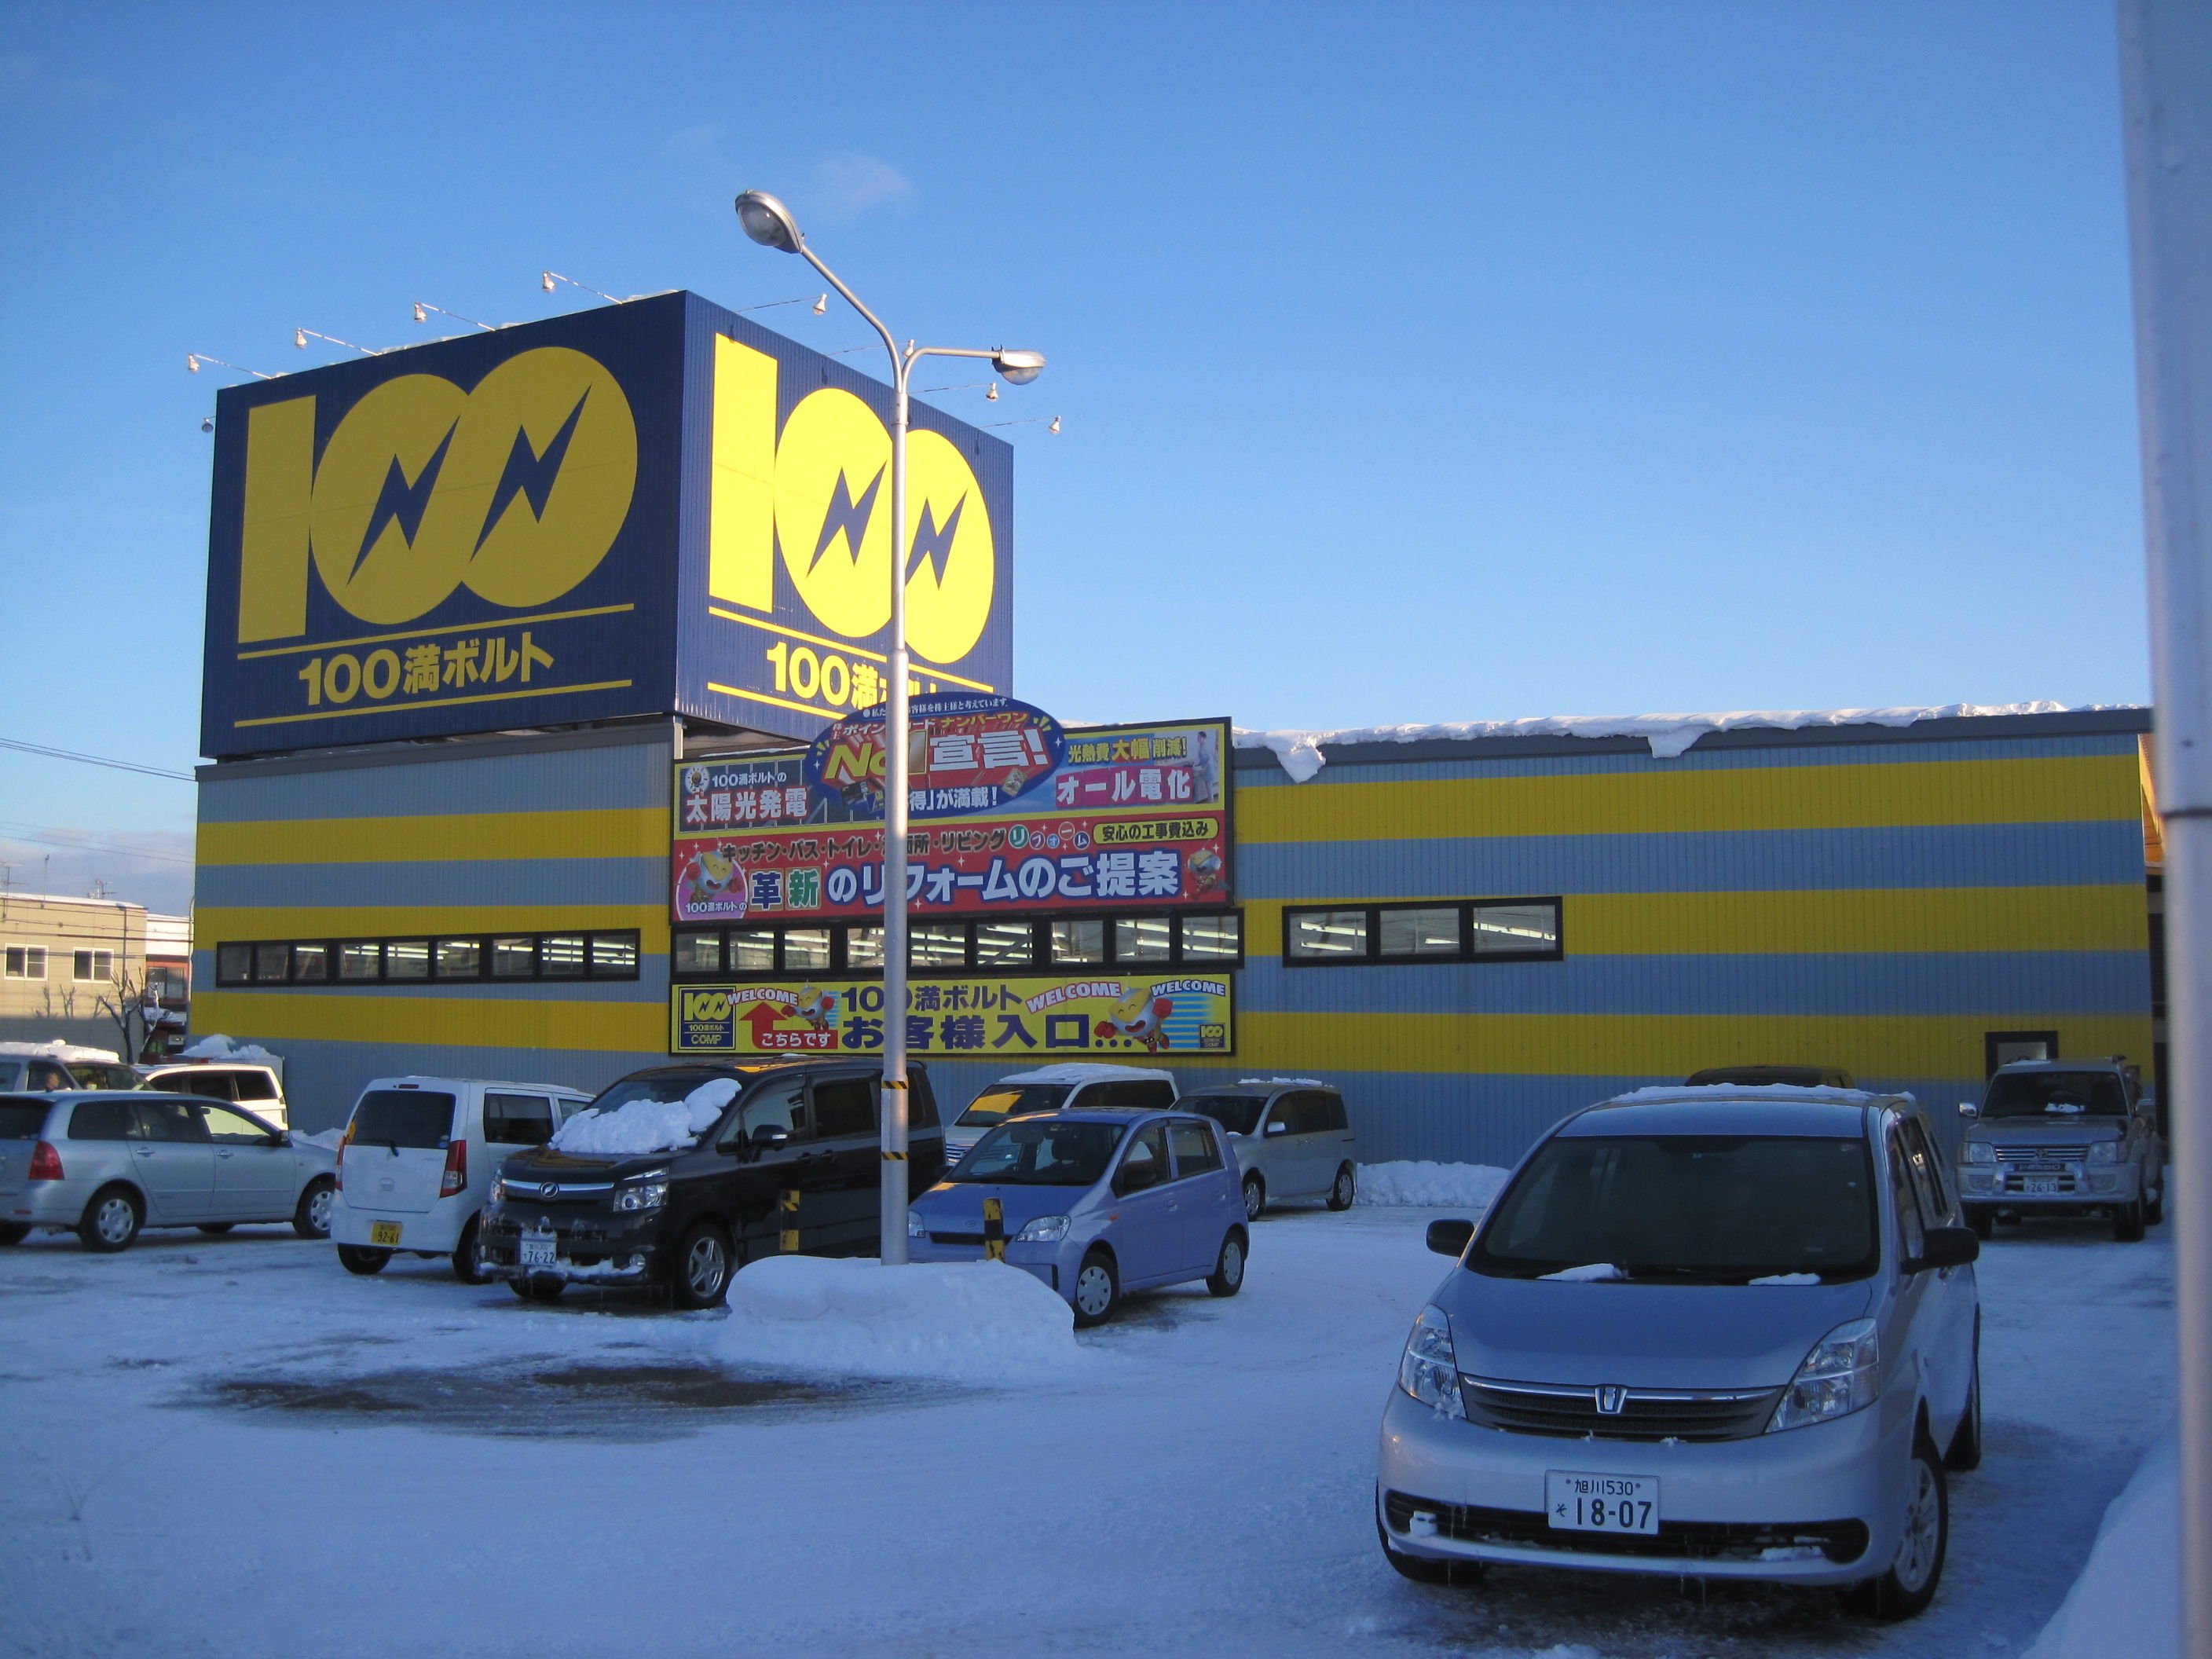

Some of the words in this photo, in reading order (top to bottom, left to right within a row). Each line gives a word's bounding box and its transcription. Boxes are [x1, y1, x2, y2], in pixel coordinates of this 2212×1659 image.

[238, 346, 638, 643] 100
[709, 332, 994, 665] 100
[298, 632, 555, 705] 100満ボルト
[767, 641, 938, 710] 100満
[843, 718, 936, 736] ポインード
[941, 712, 1029, 729] ナンバーワン
[1068, 736, 1188, 764] 光熱費大幅削減!
[712, 771, 787, 788] 100満ボルトの
[1057, 767, 1191, 805] オール電化
[686, 786, 808, 823] 太陽光発電
[907, 786, 998, 812] 得」が満載!
[1102, 821, 1209, 842] 安心の工事費込み
[685, 901, 748, 914] 100満ボルトの
[727, 987, 799, 1005] WELCOME
[841, 984, 1024, 1013] 10満ボルト
[1026, 982, 1122, 1014] WELCOME
[1150, 980, 1226, 997] WELCOME
[684, 993, 731, 1020] 100
[761, 1032, 832, 1048] こちらです
[528, 1251, 555, 1264] 76-22
[1575, 1478, 1634, 1496] 旭川530
[1577, 1496, 1653, 1529] 18-07
